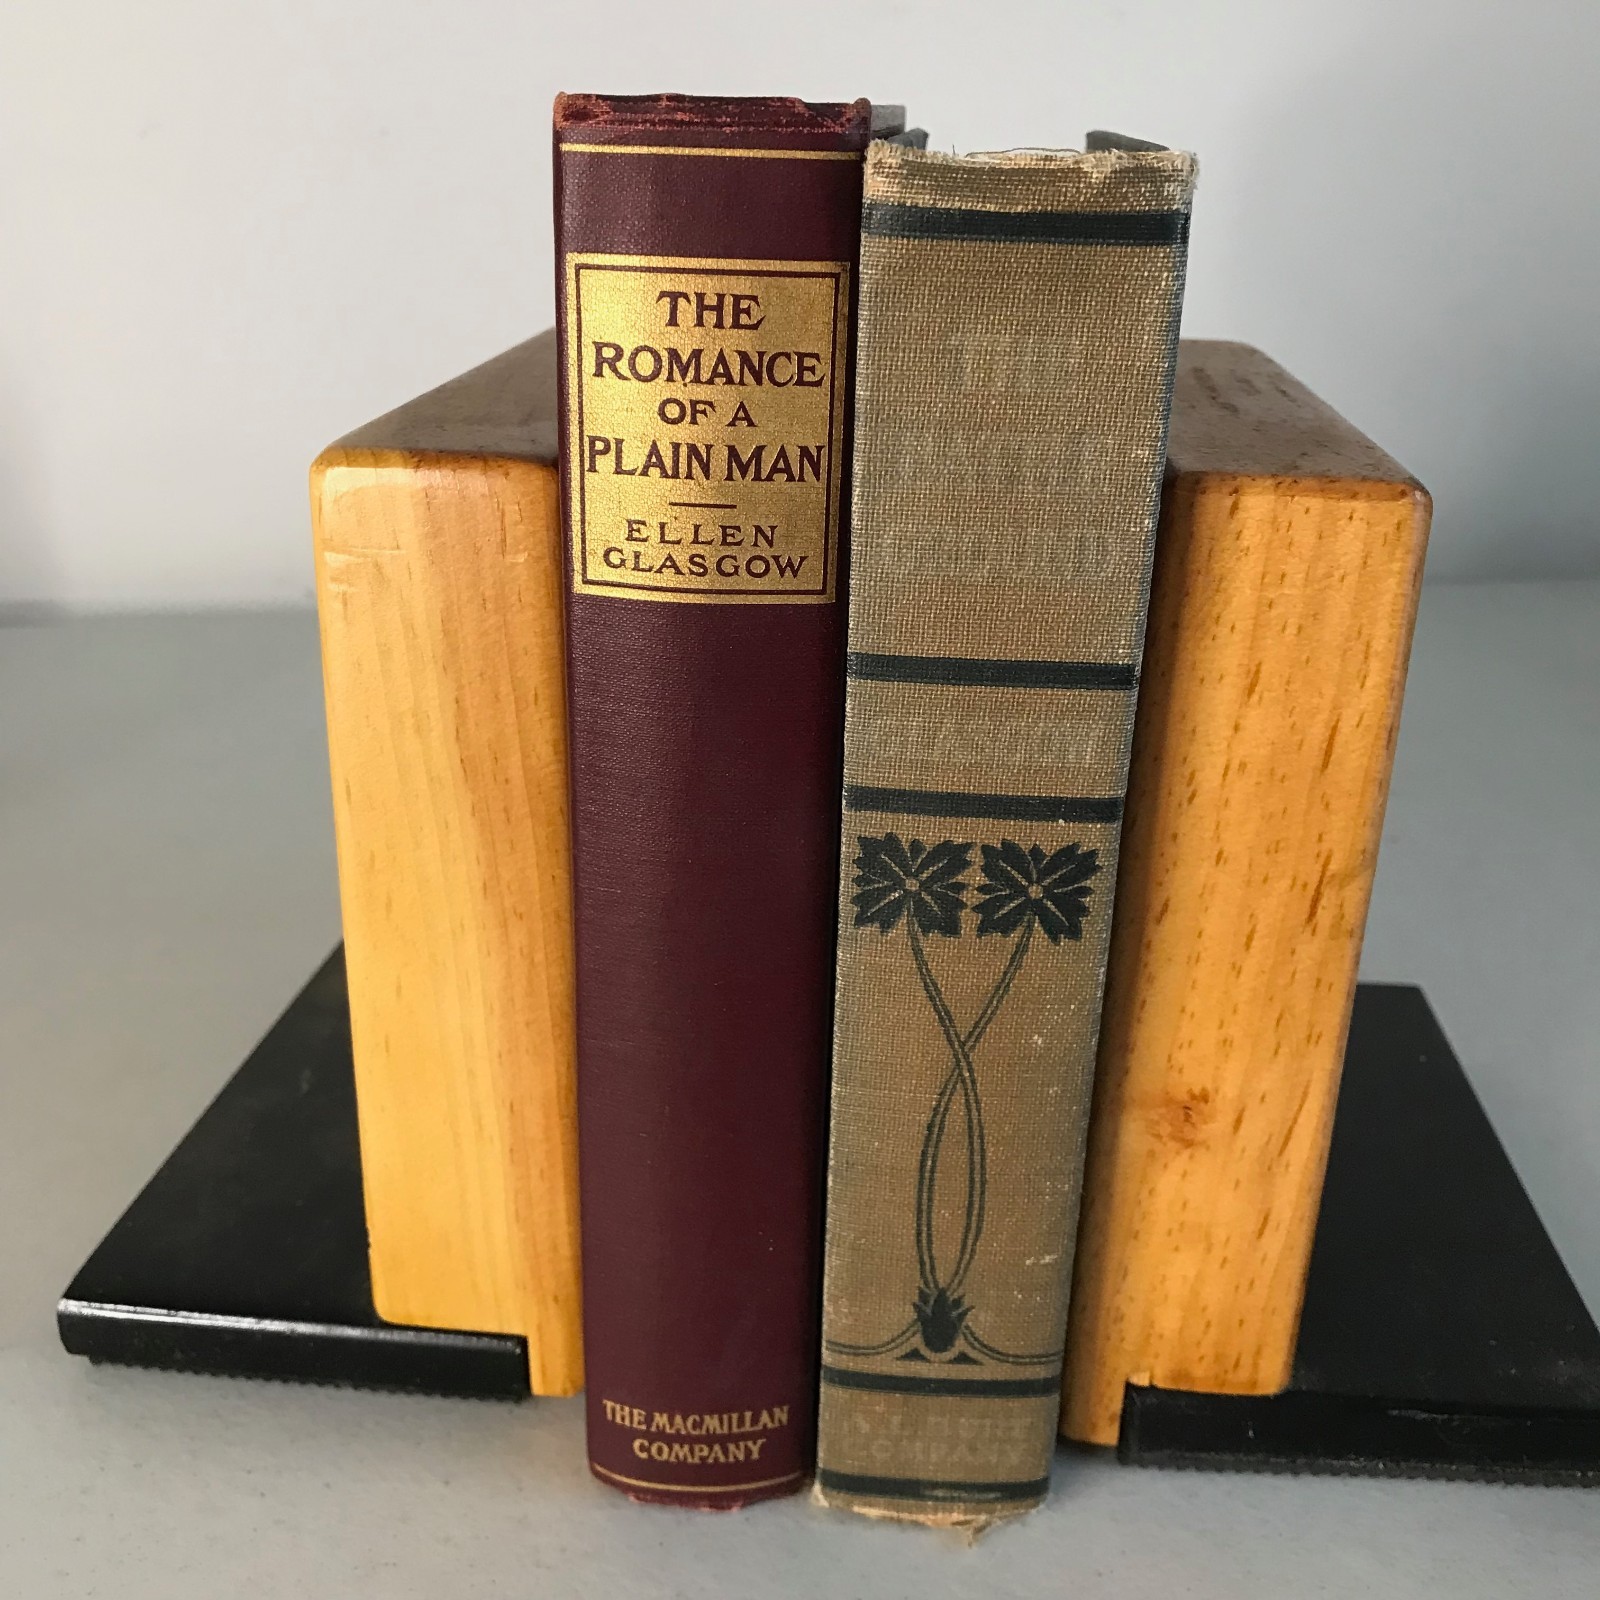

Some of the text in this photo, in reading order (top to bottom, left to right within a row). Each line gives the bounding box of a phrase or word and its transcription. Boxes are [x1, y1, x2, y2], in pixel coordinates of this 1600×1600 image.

[656, 291, 766, 331] THE
[591, 341, 826, 387] ROMANCE
[658, 398, 757, 427] OF A
[586, 435, 825, 482] PLAIN MAN
[625, 519, 778, 548] ELLEN
[603, 547, 808, 579] GLASGOW
[602, 1399, 789, 1435] THE MACMILLAN
[632, 1438, 766, 1463] COMPANY
